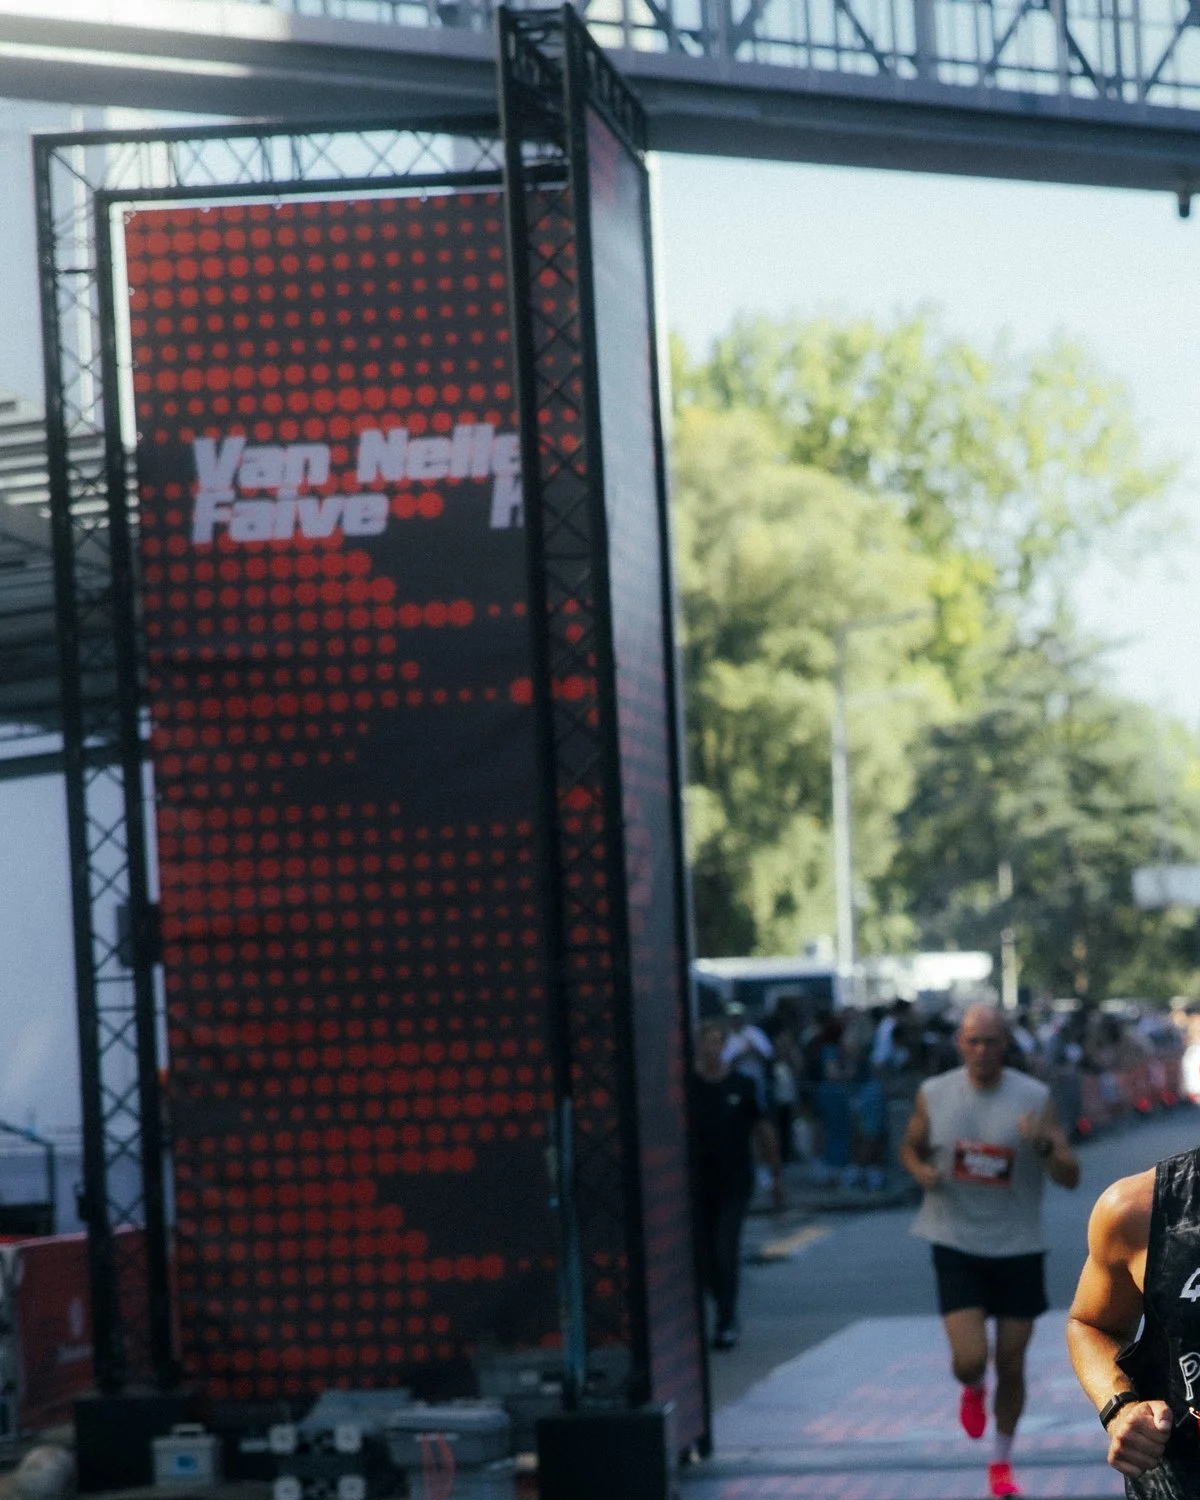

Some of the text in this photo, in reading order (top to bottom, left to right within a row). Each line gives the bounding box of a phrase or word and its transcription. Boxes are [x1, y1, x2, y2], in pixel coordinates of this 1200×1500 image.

[192, 424, 523, 488] Van Nelle
[191, 489, 389, 544] Faive
